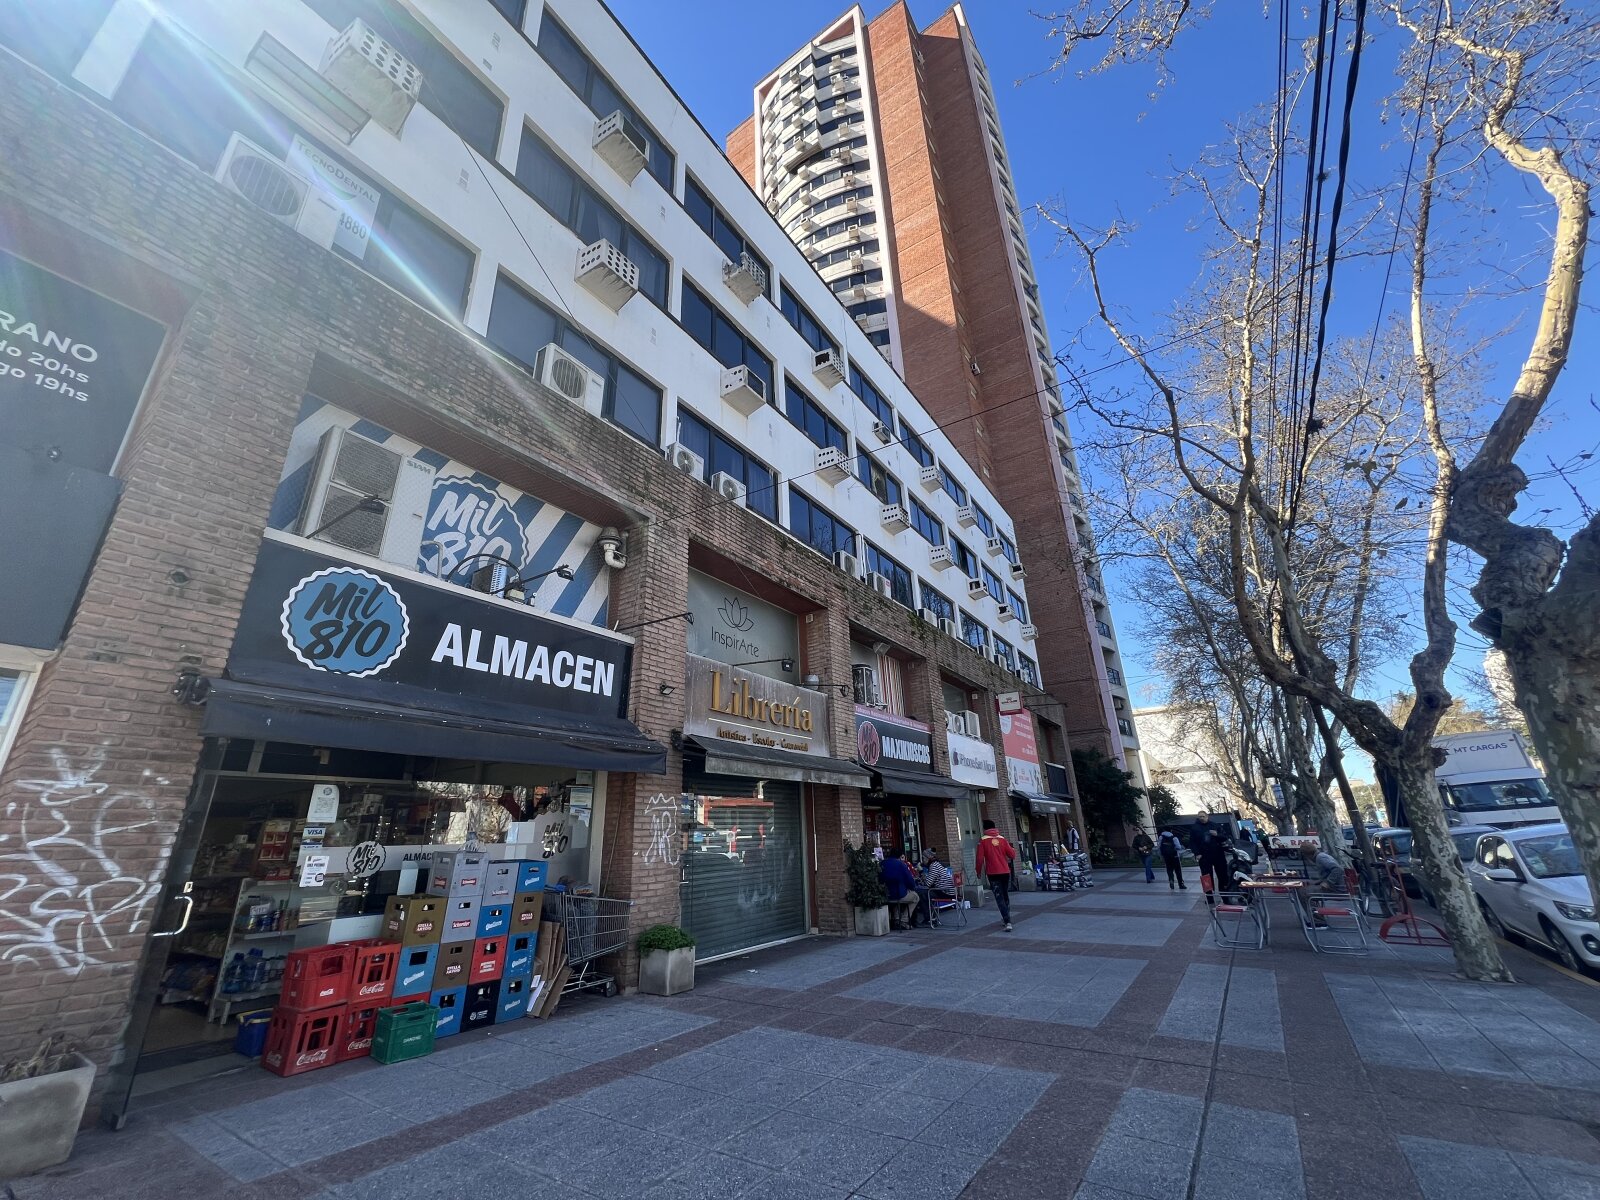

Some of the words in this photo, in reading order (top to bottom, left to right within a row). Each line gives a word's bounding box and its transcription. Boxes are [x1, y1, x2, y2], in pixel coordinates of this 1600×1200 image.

[27, 351, 89, 383] 20hs
[34, 373, 89, 402] 19hs
[427, 491, 504, 536] Mil
[425, 532, 512, 576] 810
[304, 582, 385, 621] Mil
[303, 620, 391, 660] 810
[711, 626, 760, 658] InspirArte
[431, 622, 615, 697] ALMACEN
[709, 669, 813, 732] Librería
[882, 735, 930, 765] MAXIKIOSCOS
[1453, 746, 1467, 754] MT
[1469, 742, 1508, 752] CARGAS
[353, 856, 380, 875] 810
